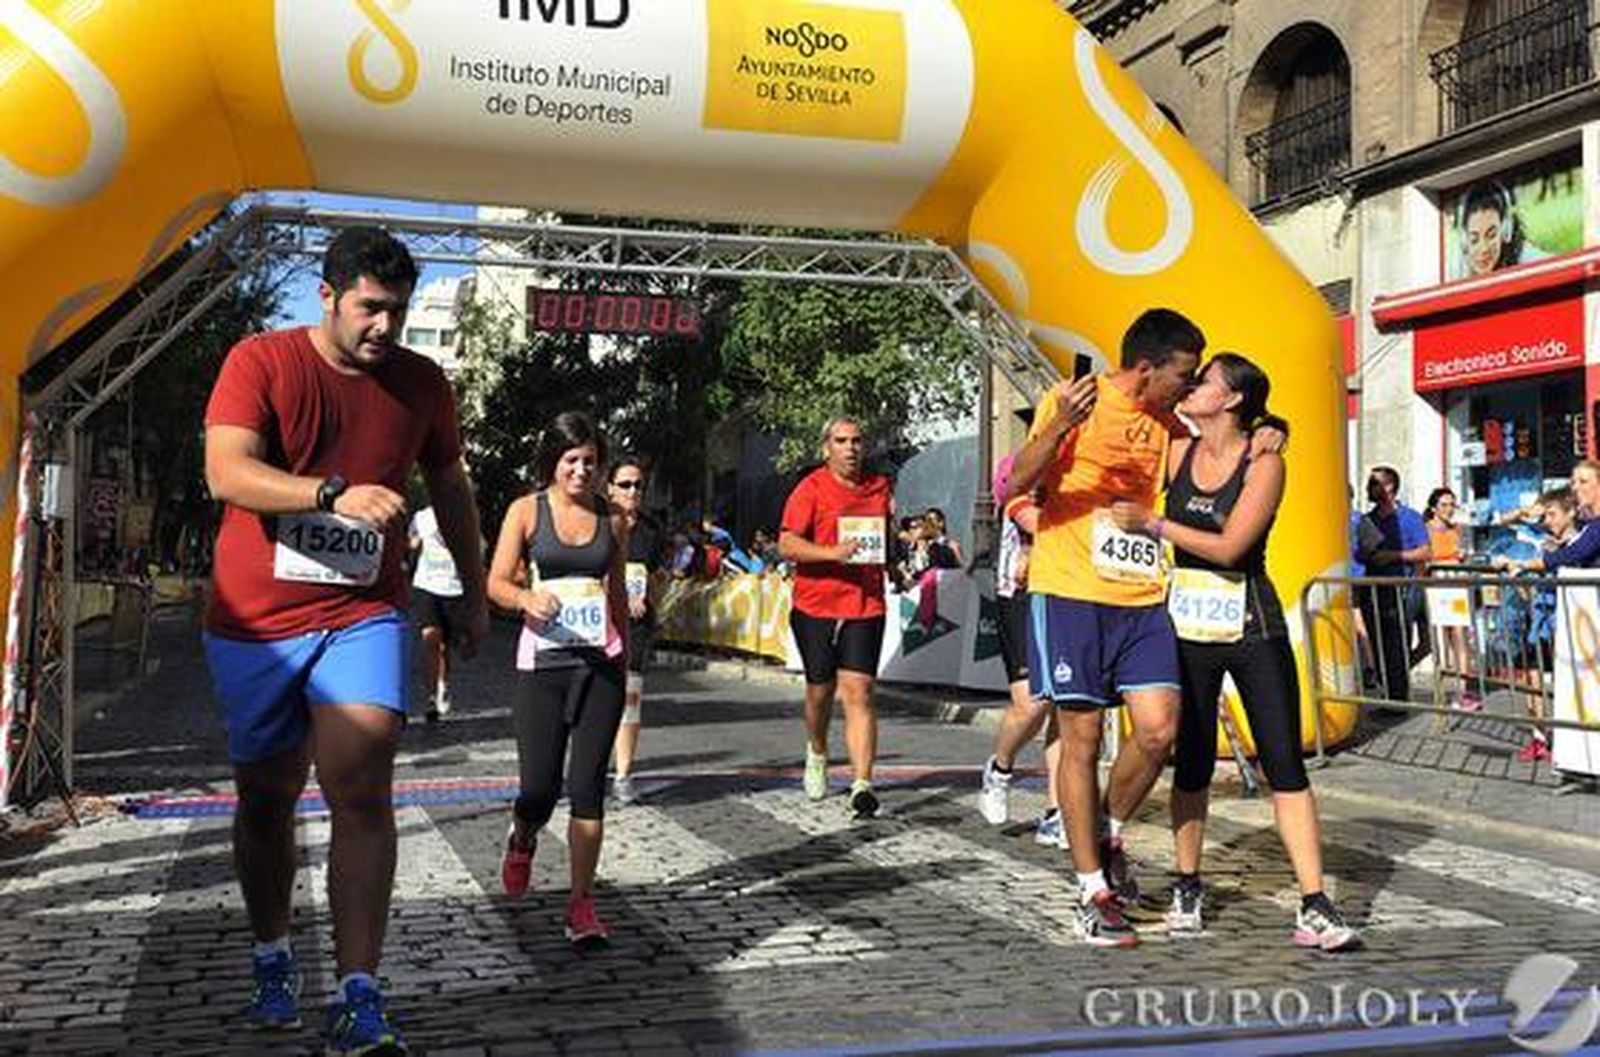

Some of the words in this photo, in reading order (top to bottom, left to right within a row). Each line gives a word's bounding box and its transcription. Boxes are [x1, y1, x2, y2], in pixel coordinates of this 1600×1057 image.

[450, 56, 550, 87] Instituto
[556, 65, 672, 99] Municipal
[485, 93, 518, 116] de
[524, 94, 633, 125] Deportes
[1511, 340, 1567, 364] Sonido
[289, 524, 378, 556] 15200
[1101, 536, 1156, 567] 4365
